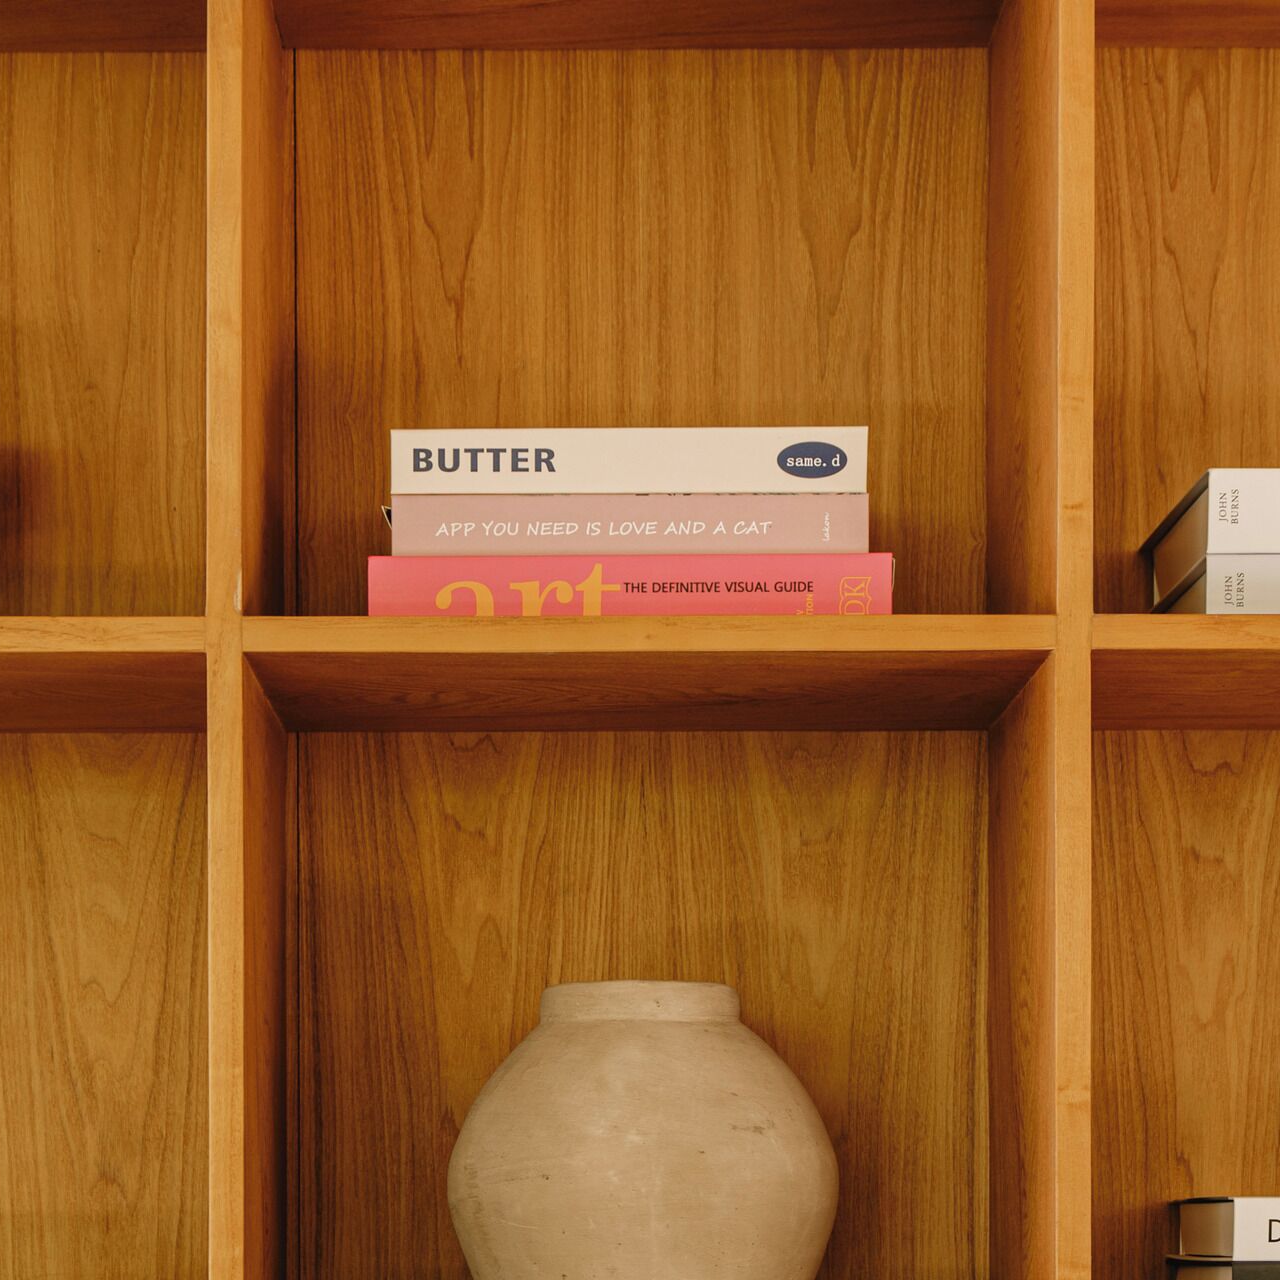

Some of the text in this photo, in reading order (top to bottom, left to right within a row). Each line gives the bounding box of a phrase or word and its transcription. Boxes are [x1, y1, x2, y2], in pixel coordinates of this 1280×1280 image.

[412, 447, 557, 473] BUTTER
[1218, 491, 1229, 522] JOHN
[1231, 488, 1240, 525] BURNS
[435, 520, 773, 537] APP YOU NEED IS LOVE AND A CAT
[435, 563, 621, 616] art
[623, 580, 814, 593] THE DEFINITIVE VISUAL GUIDE
[1223, 575, 1234, 606] JOHN
[1236, 571, 1245, 608] BURNS
